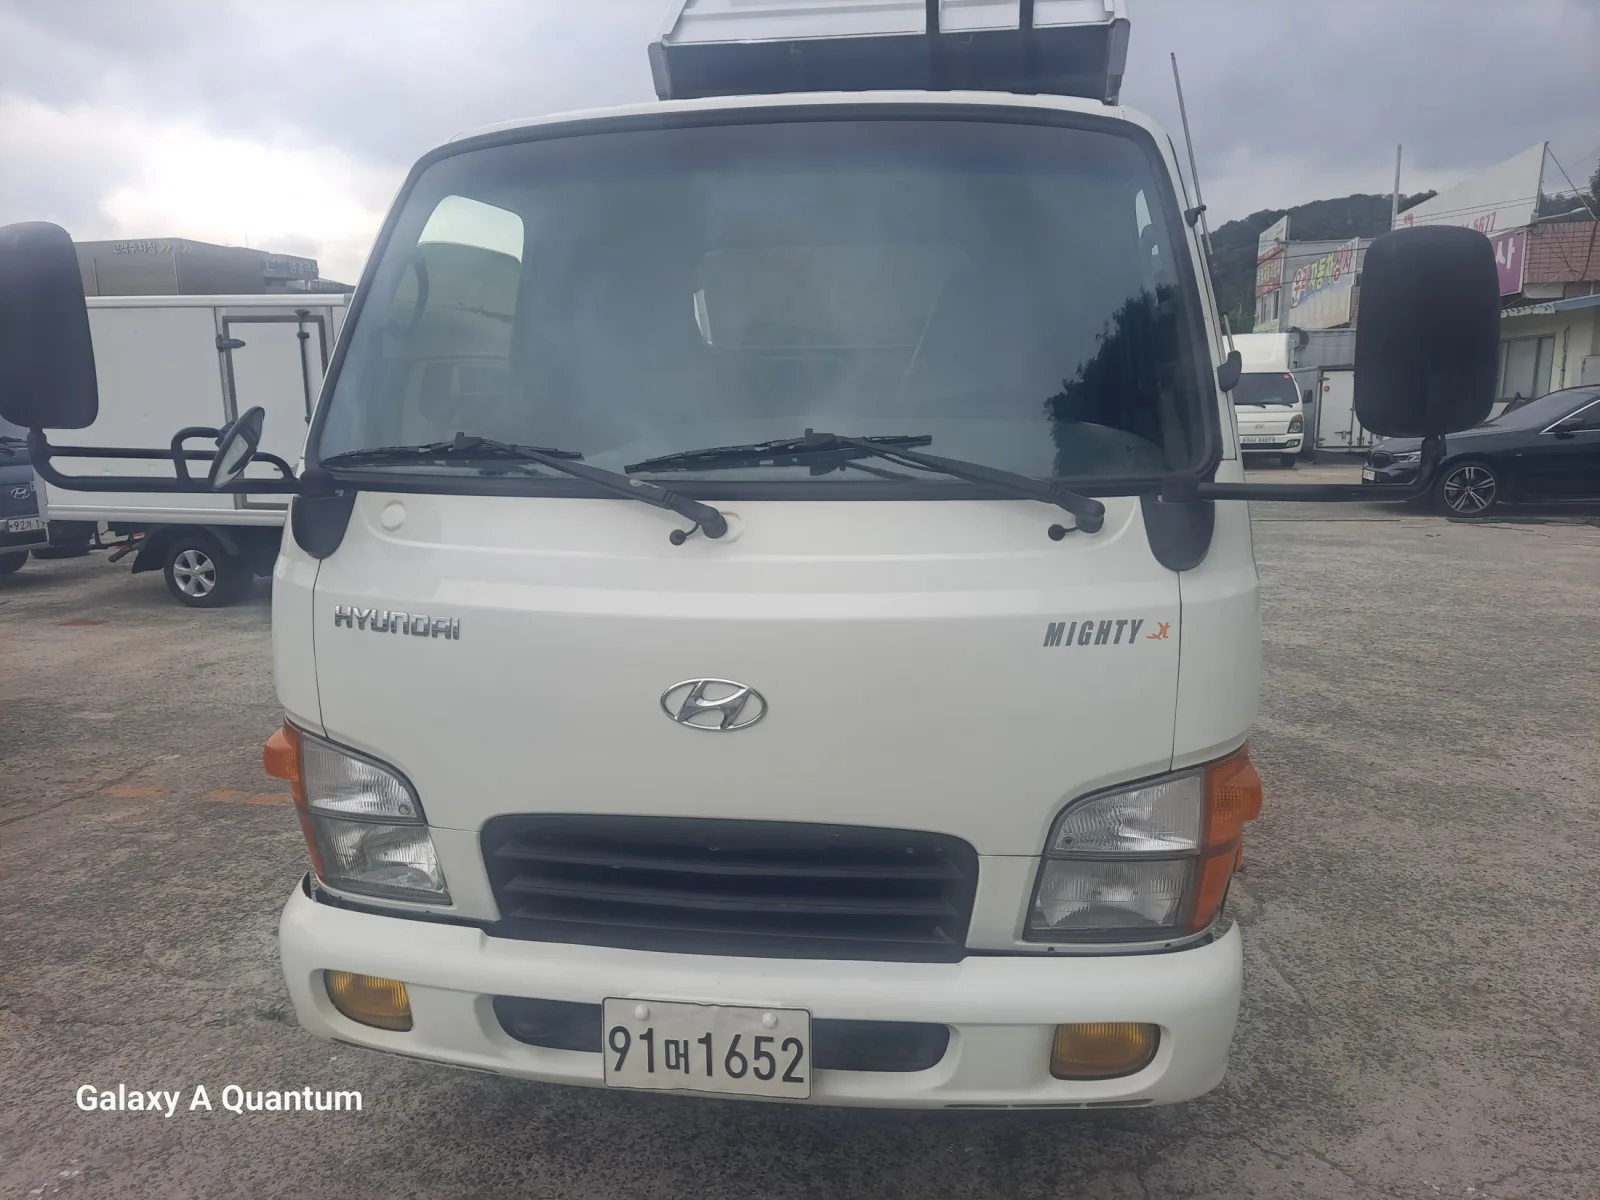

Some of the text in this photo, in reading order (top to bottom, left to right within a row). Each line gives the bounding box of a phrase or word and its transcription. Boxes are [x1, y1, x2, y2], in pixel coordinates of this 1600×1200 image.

[113, 240, 156, 254] 고객주차장
[334, 605, 460, 640] HYUNDAI
[1043, 618, 1144, 647] MIGHTY
[608, 1025, 804, 1083] 91머1652
